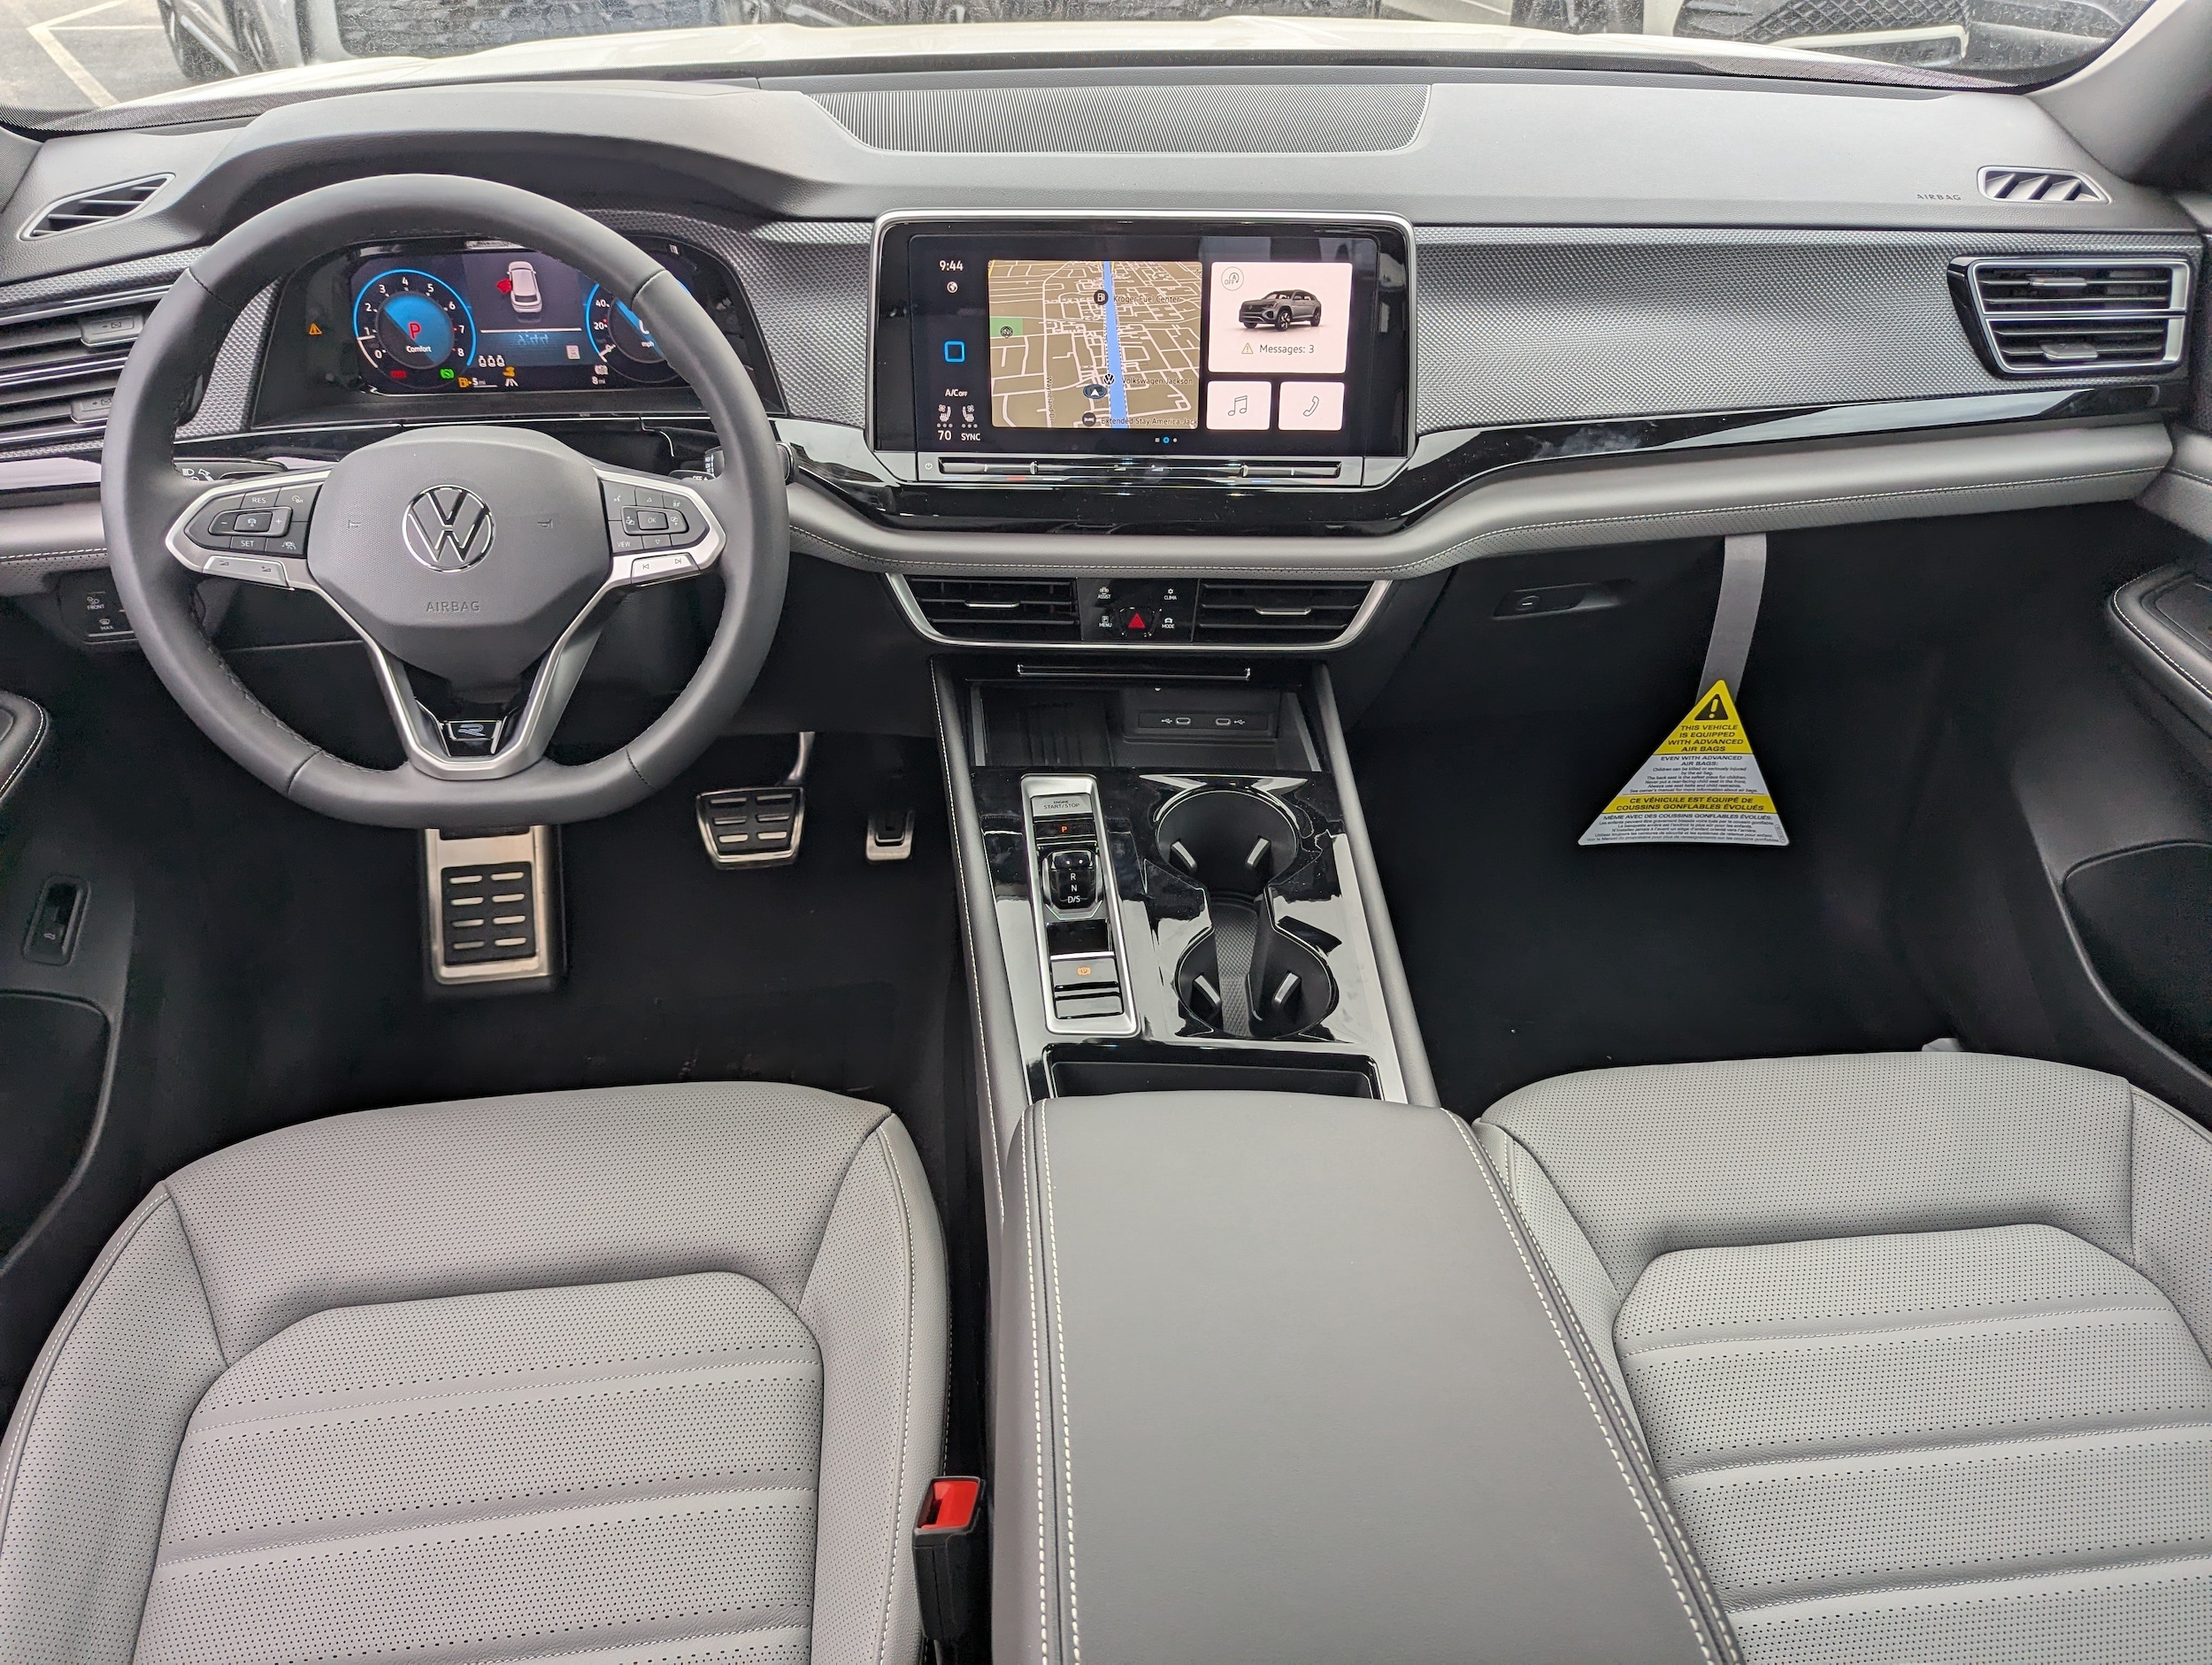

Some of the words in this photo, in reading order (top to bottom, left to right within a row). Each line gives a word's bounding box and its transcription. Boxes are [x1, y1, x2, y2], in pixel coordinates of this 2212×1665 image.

[940, 260, 964, 271] 9:44
[402, 277, 409, 286] 4
[379, 284, 386, 293] 3
[427, 284, 434, 293] 5
[409, 322, 421, 340] P
[459, 325, 465, 334] 7
[374, 349, 382, 358] 0
[457, 348, 465, 357] 8
[1260, 344, 1305, 355] Messages:
[592, 376, 598, 385] 8
[1046, 376, 1056, 413] Wayneland
[938, 430, 951, 441] 70
[426, 602, 480, 612] AIRBAG
